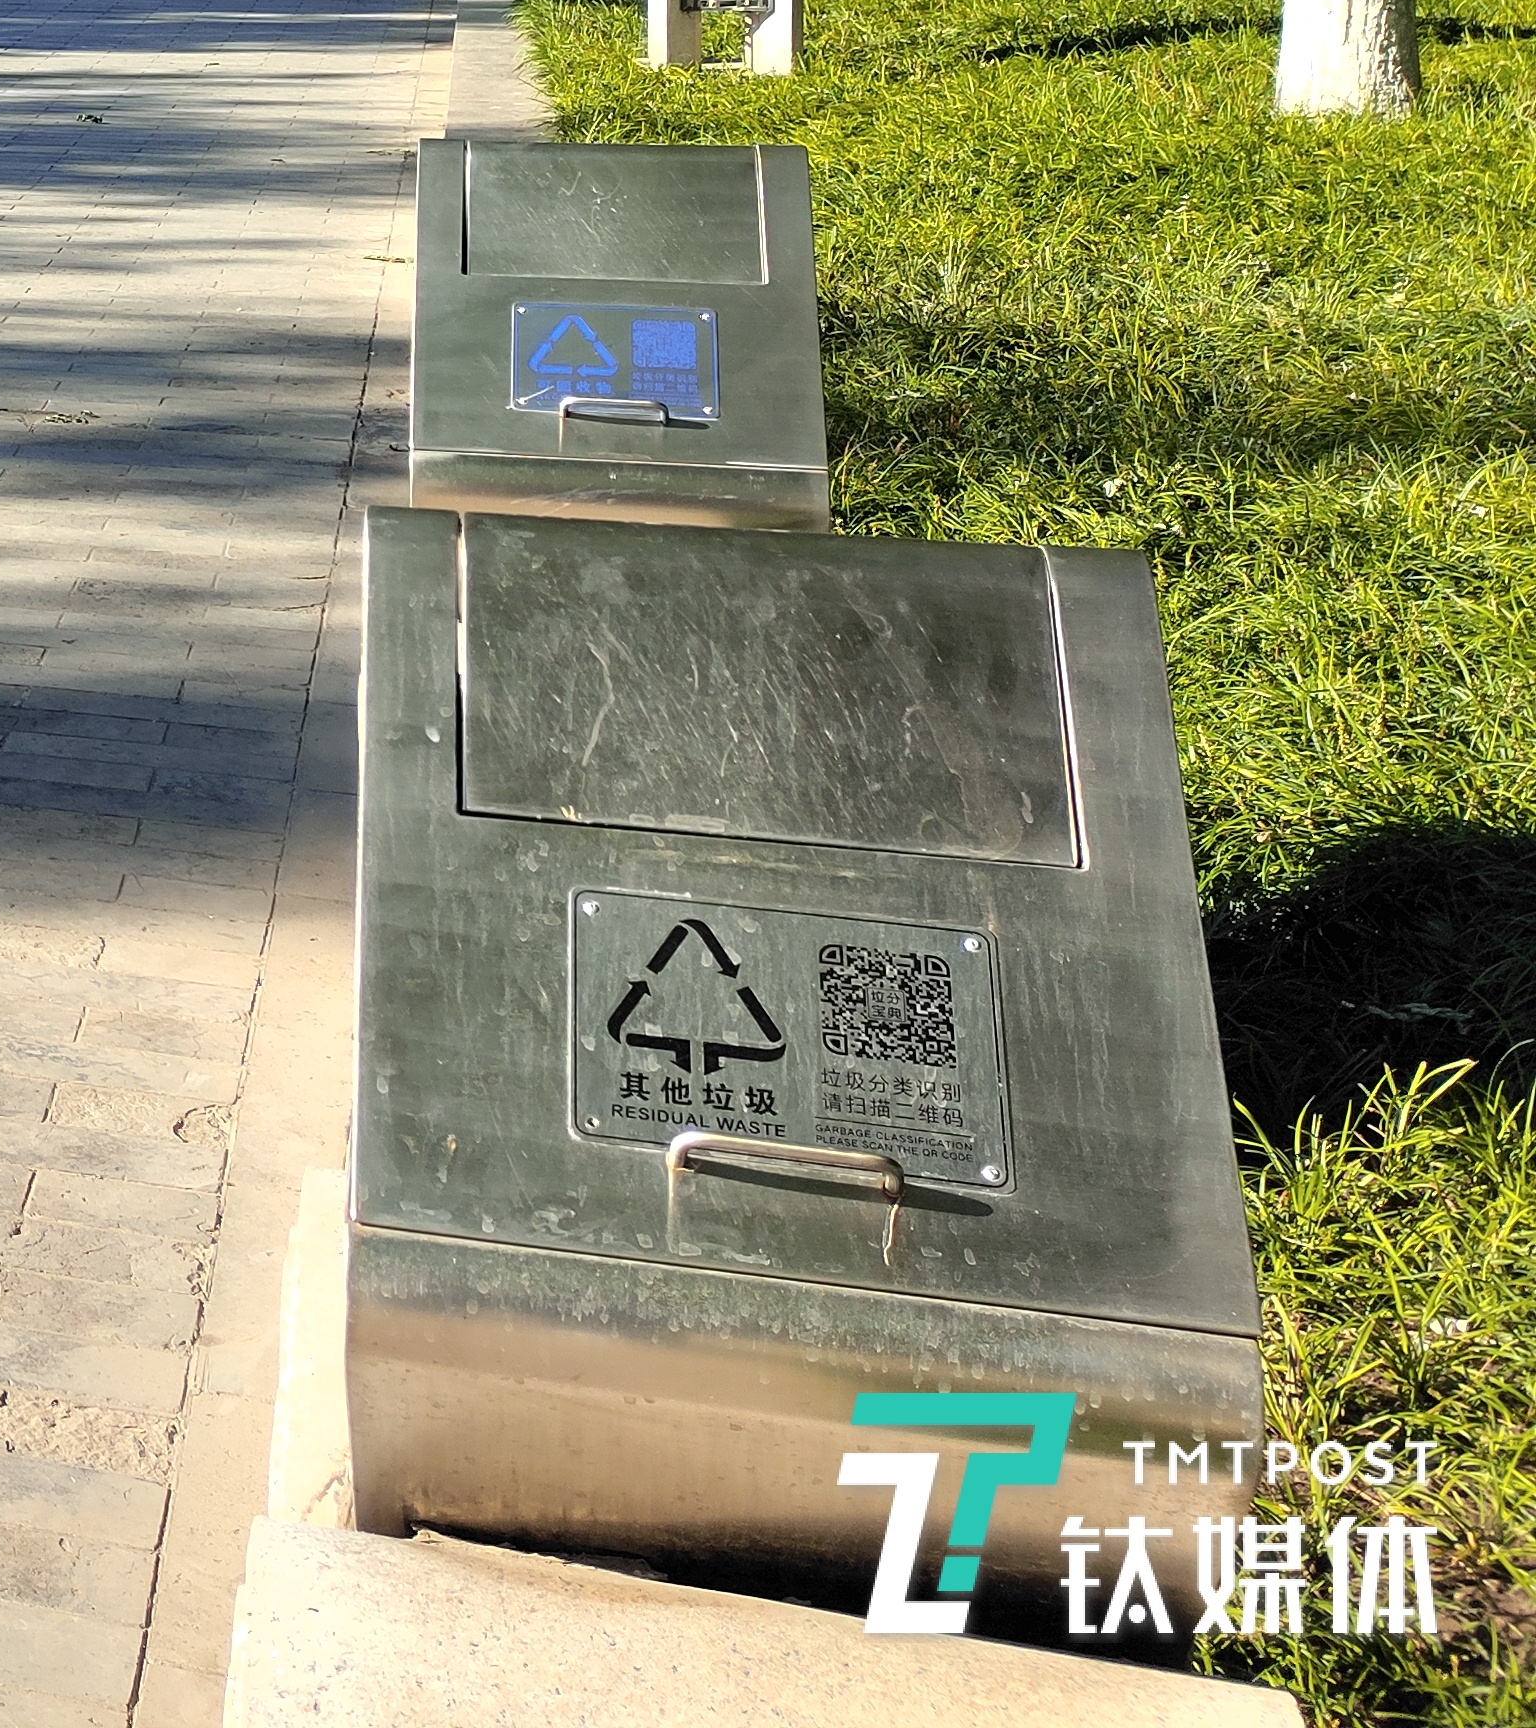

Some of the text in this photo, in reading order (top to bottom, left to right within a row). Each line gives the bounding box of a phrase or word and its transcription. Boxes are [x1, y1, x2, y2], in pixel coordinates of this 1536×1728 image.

[536, 379, 612, 394] 可回收物
[619, 1071, 778, 1116] 其他垃圾
[821, 1067, 961, 1103] 垃圾分类识别
[611, 1104, 786, 1138] RESIDUAL WASTE
[822, 1092, 963, 1128] 请扫描二维码
[815, 1124, 973, 1151] GARBAGE CLASSIFICATION
[815, 1134, 974, 1162] PLEASE SCAN THE QR CODE
